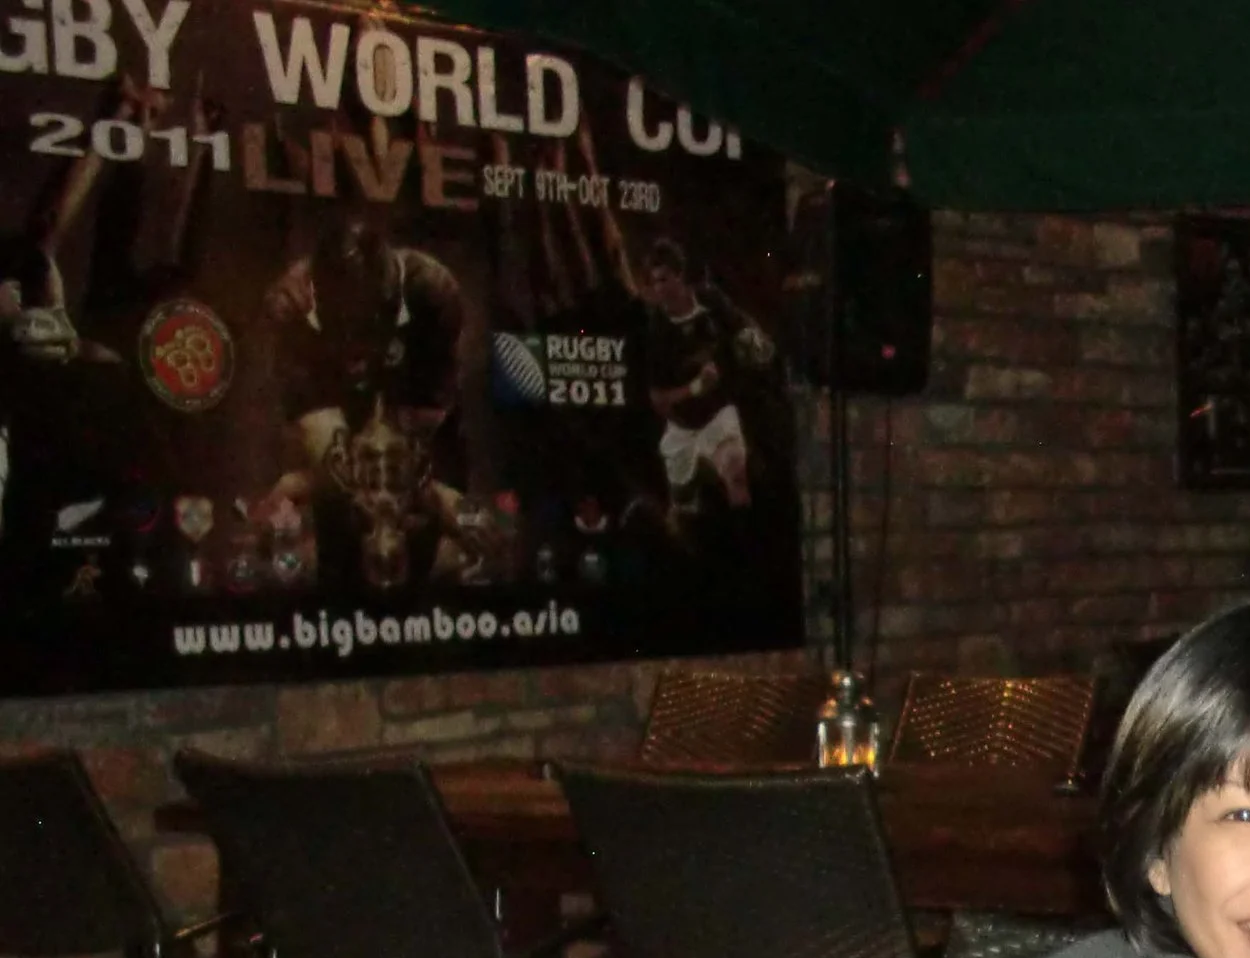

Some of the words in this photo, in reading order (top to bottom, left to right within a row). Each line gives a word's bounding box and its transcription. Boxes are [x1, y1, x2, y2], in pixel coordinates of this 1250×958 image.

[253, 10, 580, 138] WORLD
[29, 111, 230, 171] 2011
[243, 122, 479, 211] LIVE
[483, 164, 525, 199] SEPT
[618, 180, 661, 213] 23RD
[546, 333, 625, 362] RUGBY
[548, 362, 598, 378] WORLD
[549, 378, 626, 406] 2011
[173, 599, 580, 657] www.bigbamboo.asia
